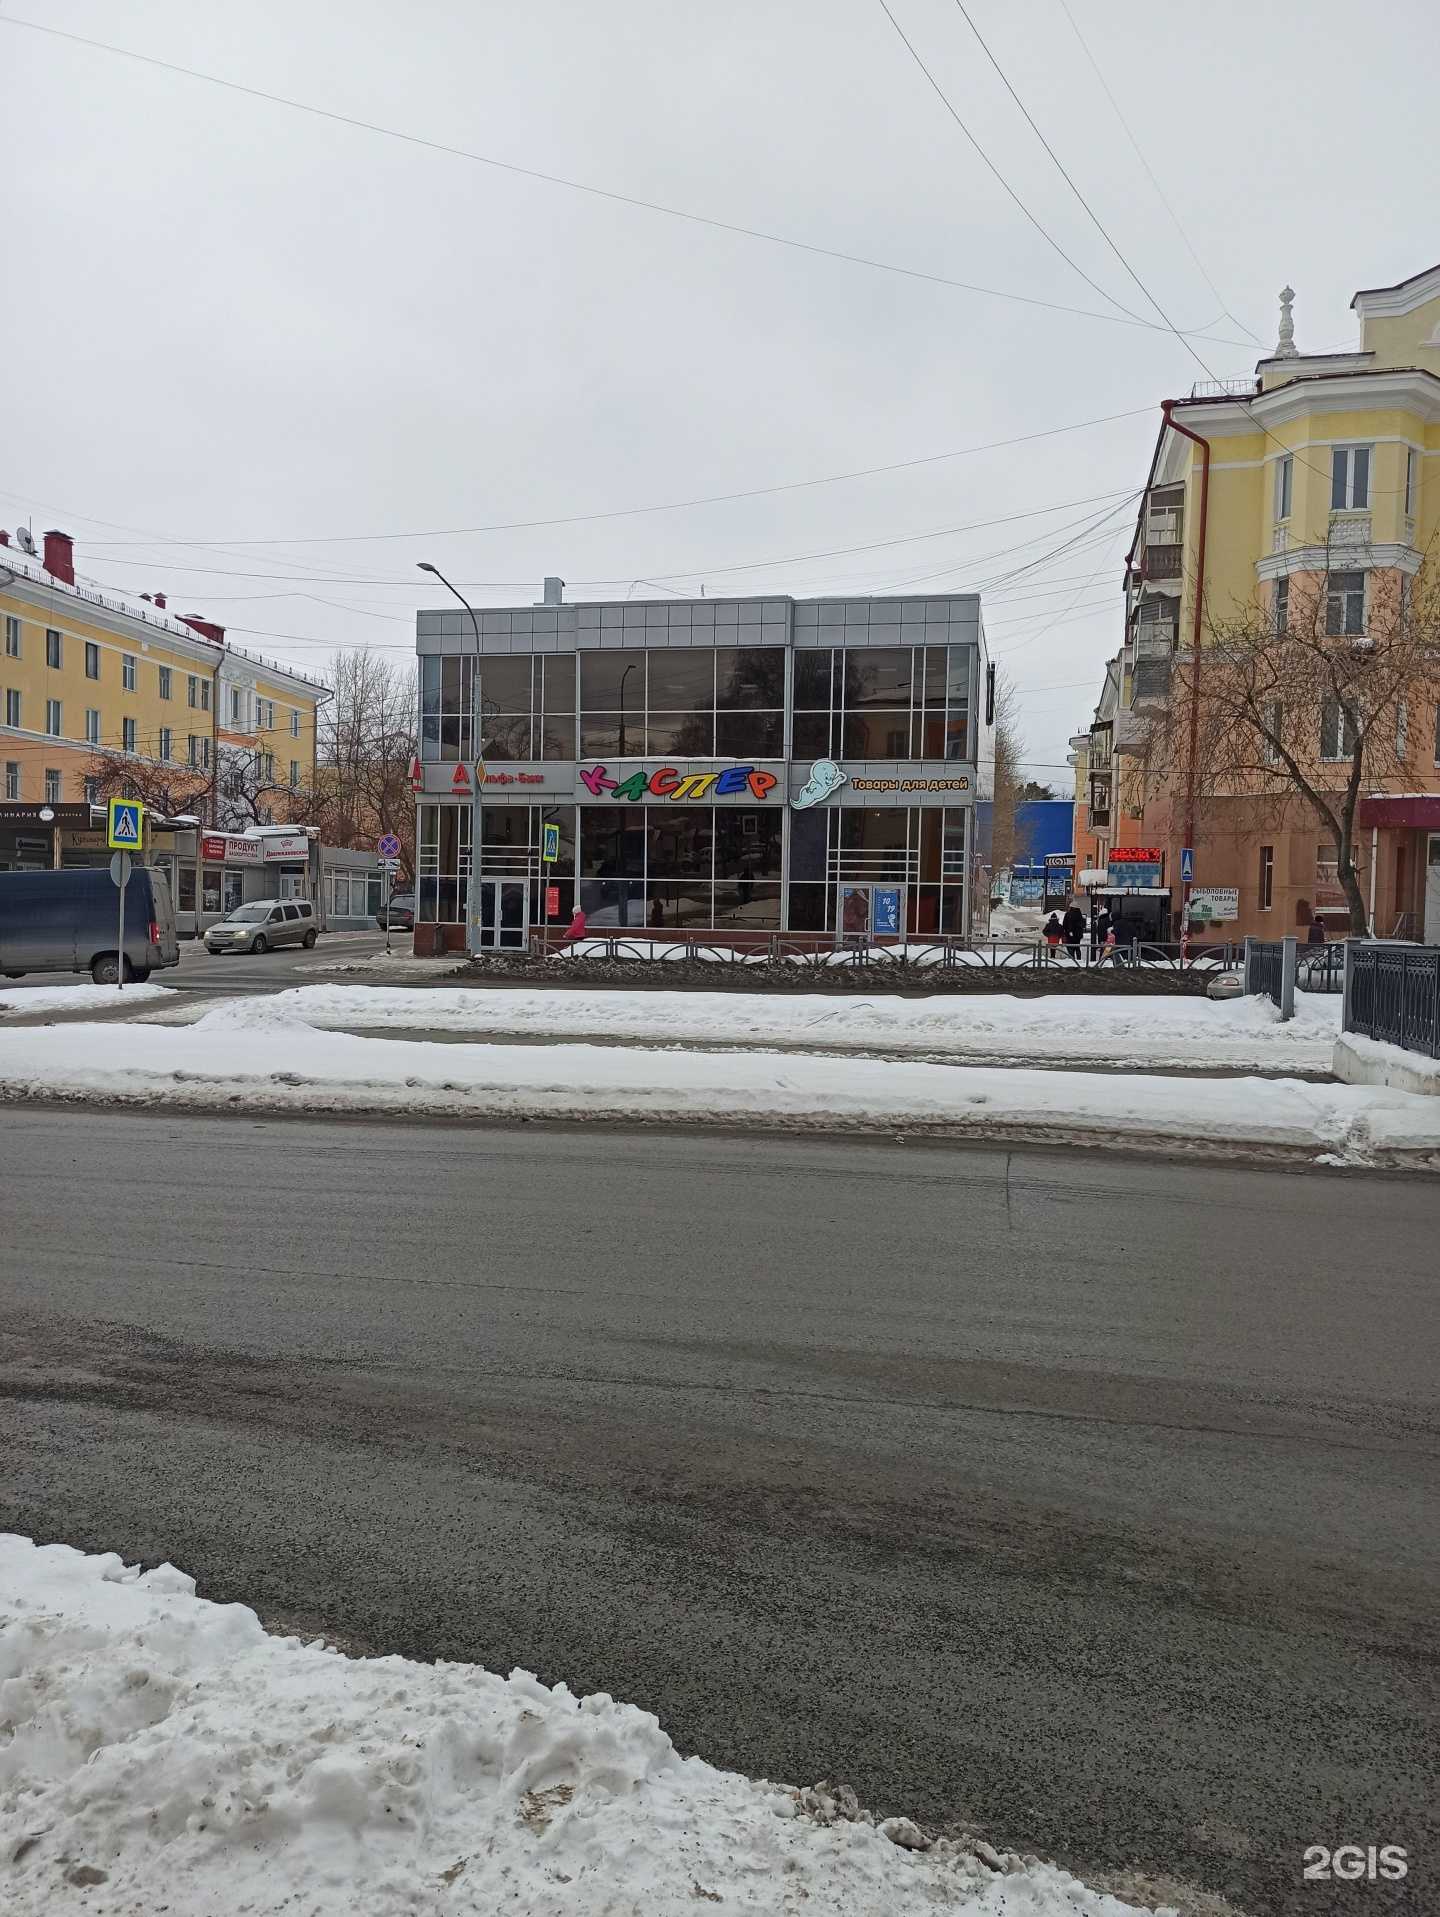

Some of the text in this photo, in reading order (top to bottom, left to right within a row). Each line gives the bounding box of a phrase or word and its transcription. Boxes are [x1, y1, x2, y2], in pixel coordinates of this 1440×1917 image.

[579, 765, 777, 801] КАСПЕР
[852, 777, 968, 792] Товары для детей
